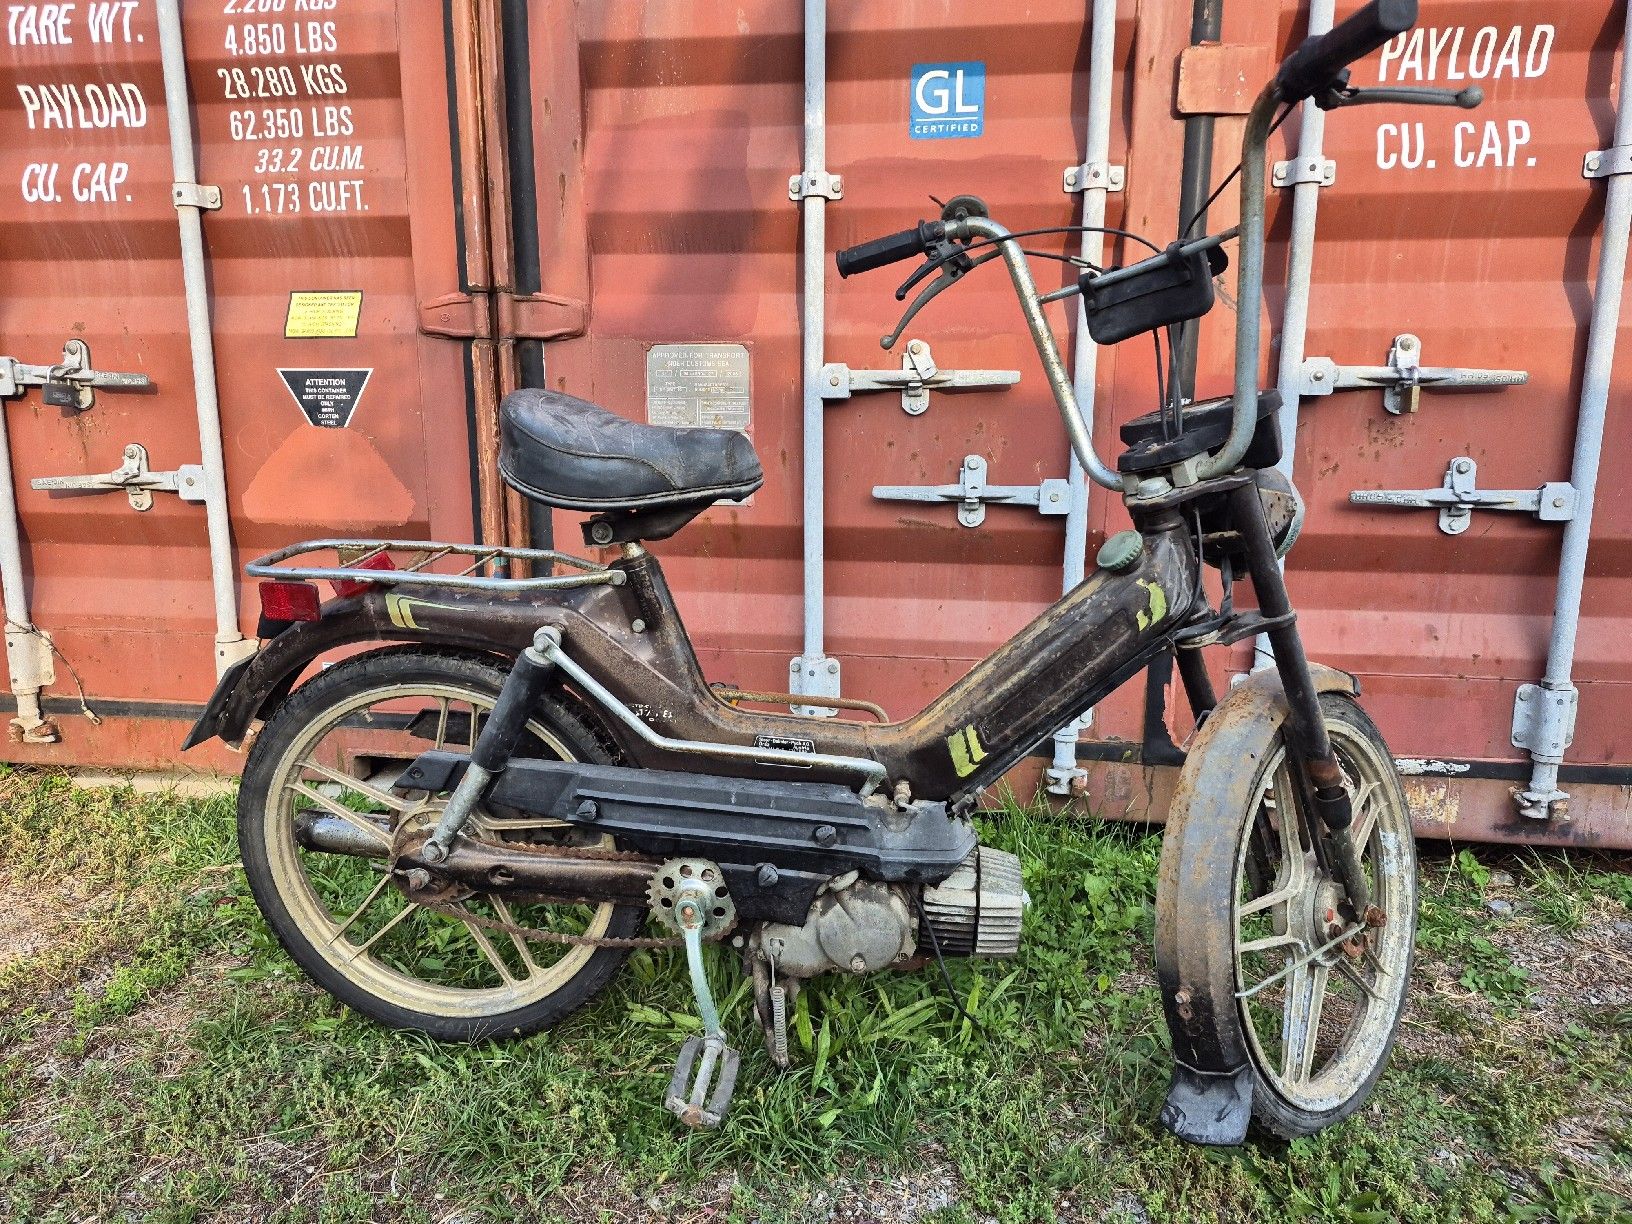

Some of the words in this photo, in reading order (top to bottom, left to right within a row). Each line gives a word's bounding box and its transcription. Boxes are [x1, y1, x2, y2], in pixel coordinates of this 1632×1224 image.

[7, 4, 73, 45] TARE
[88, 1, 144, 43] WT.
[224, 23, 286, 55] 4.850
[294, 21, 337, 53] LBS
[1378, 24, 1555, 81] PAYLOAD
[217, 65, 297, 99] 28.280
[300, 63, 347, 95] KGS
[915, 69, 979, 114] GL
[17, 83, 147, 129] PAYLOAD
[229, 108, 303, 140] 62.350
[312, 106, 354, 137] LBS
[914, 123, 978, 134] CERTIFIED
[1376, 122, 1436, 169] CU.
[1454, 119, 1537, 168] CAP.
[254, 147, 302, 173] 33.2
[309, 145, 365, 171] CU.M.
[21, 164, 62, 203] CU.
[72, 162, 132, 202] CAP.
[242, 183, 300, 214] 1.173
[305, 378, 346, 386] ATTENTION
